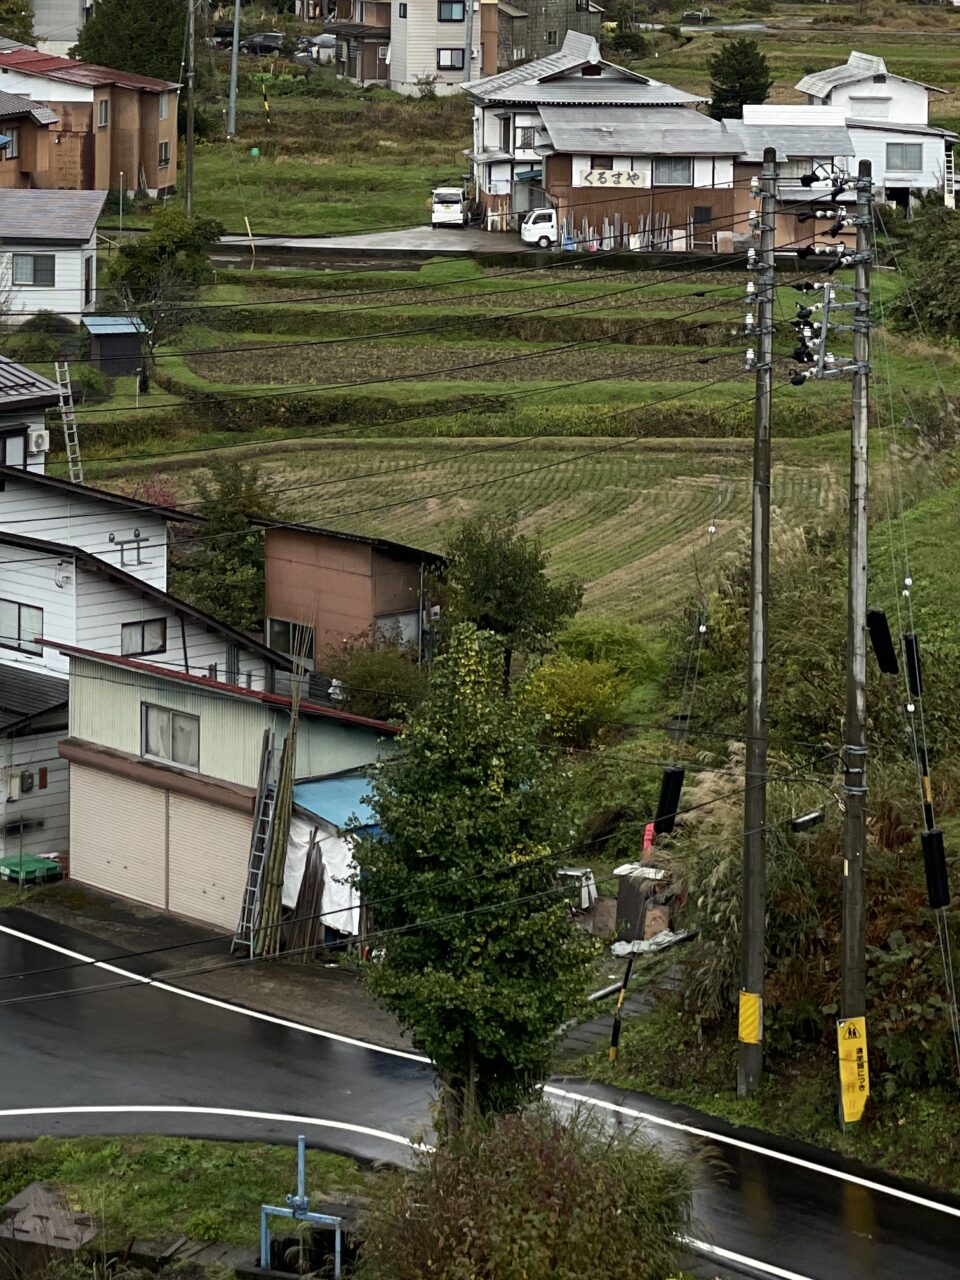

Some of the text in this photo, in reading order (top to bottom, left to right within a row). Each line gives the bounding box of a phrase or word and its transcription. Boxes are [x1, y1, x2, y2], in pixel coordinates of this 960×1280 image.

[584, 171, 640, 185] くるまや
[856, 1047, 866, 1092] 通学路につき
